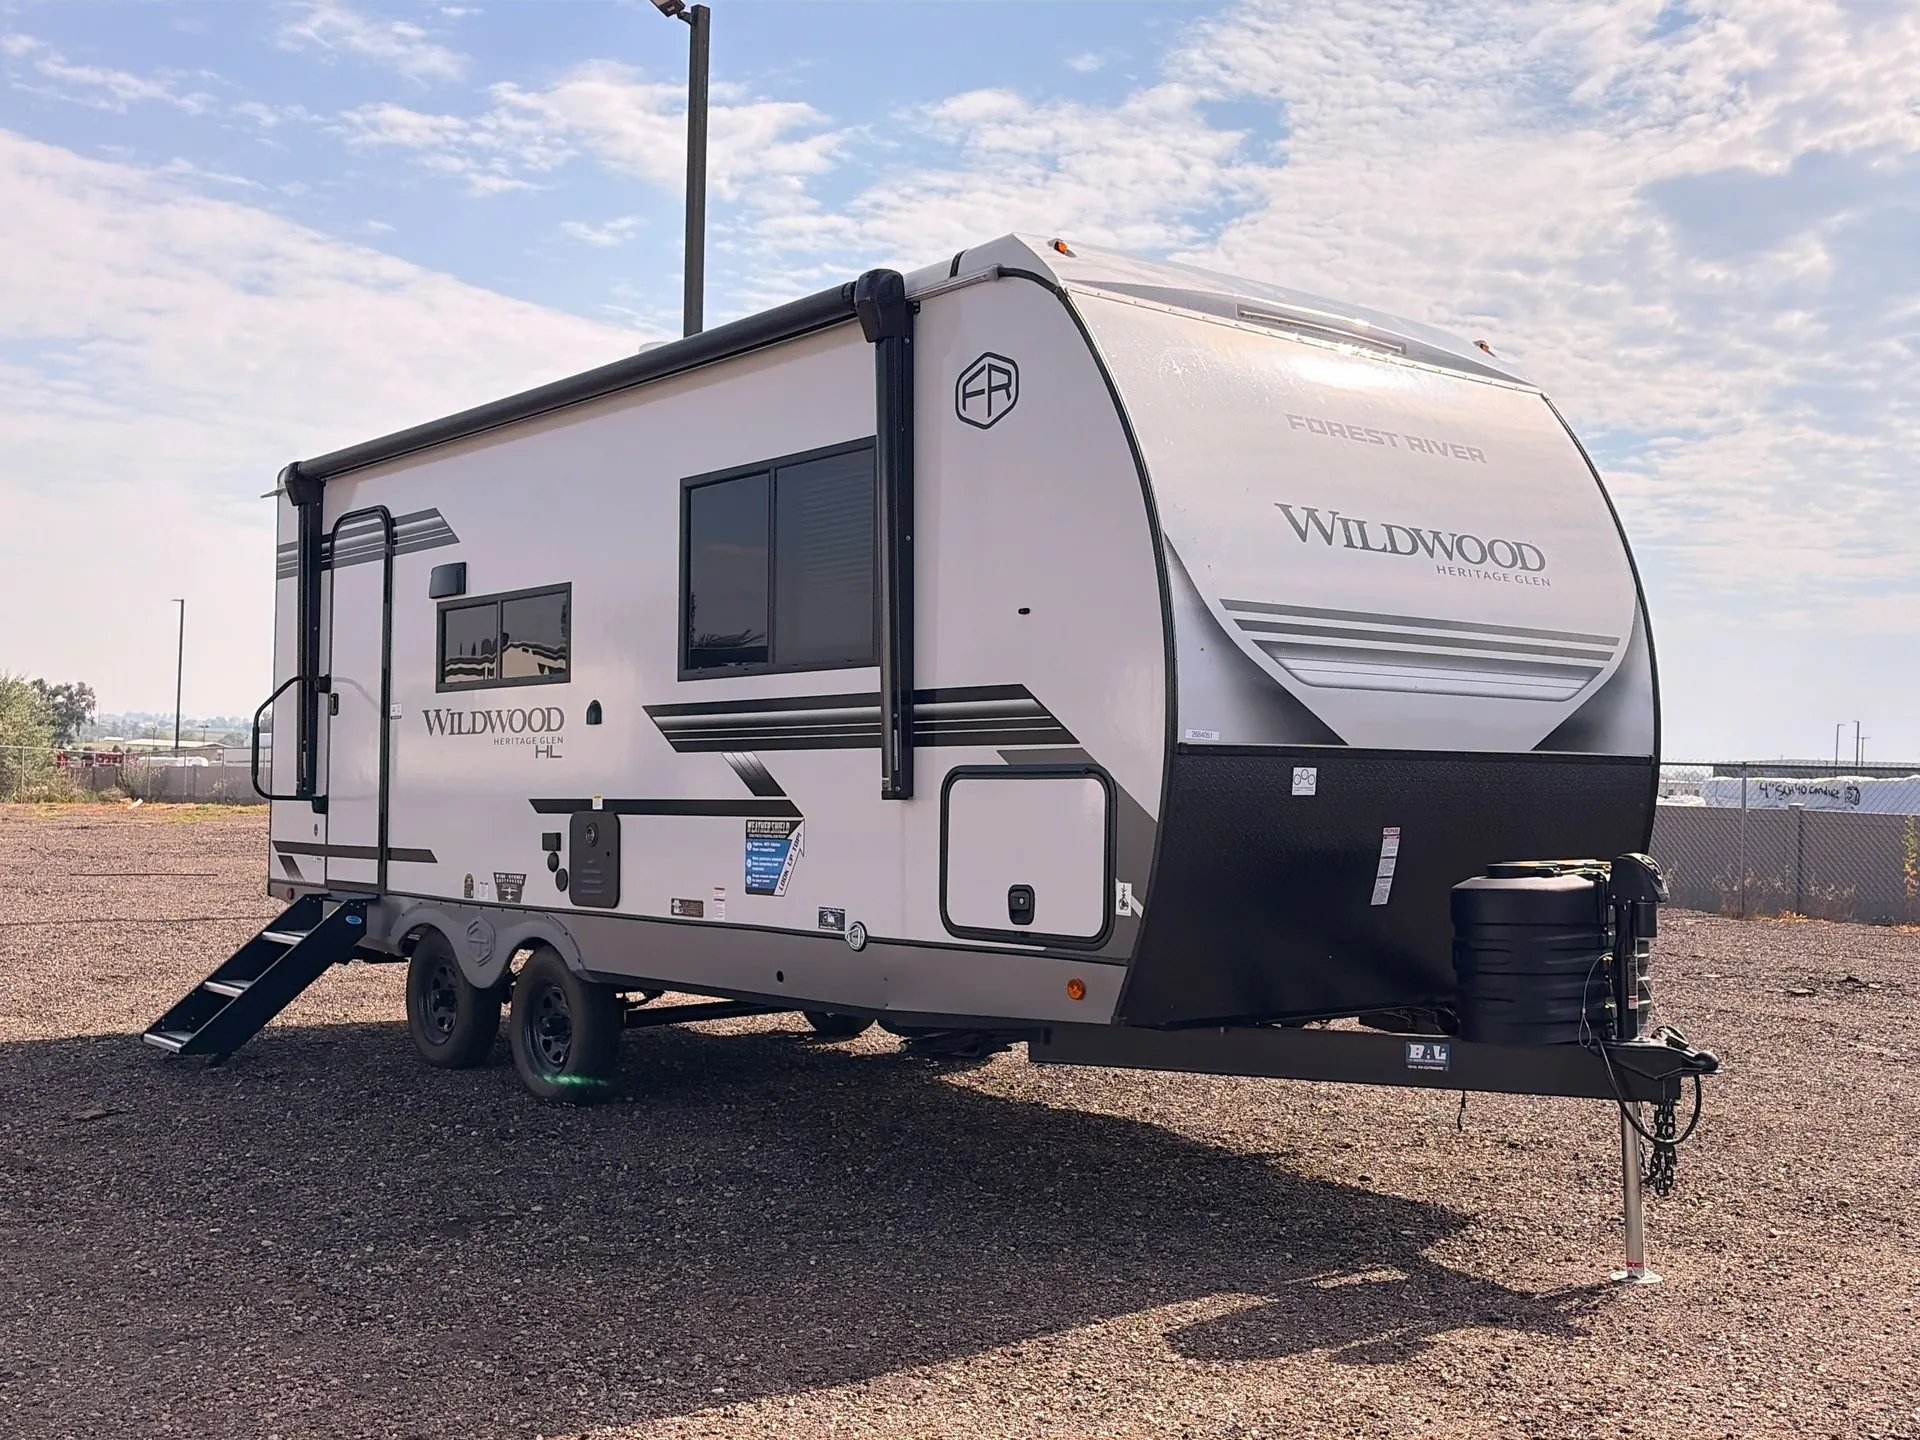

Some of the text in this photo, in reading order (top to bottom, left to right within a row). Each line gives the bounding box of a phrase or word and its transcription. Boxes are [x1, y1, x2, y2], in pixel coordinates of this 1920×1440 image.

[1285, 413, 1488, 464] FOREST RIVER
[1274, 502, 1546, 573] WILDWOOD
[1436, 564, 1551, 587] HERITAGE GLEN
[422, 706, 565, 736] WILDWOOD
[493, 736, 564, 746] HERITAGE GLEN
[535, 745, 562, 759] HL
[778, 869, 790, 891] LOOK
